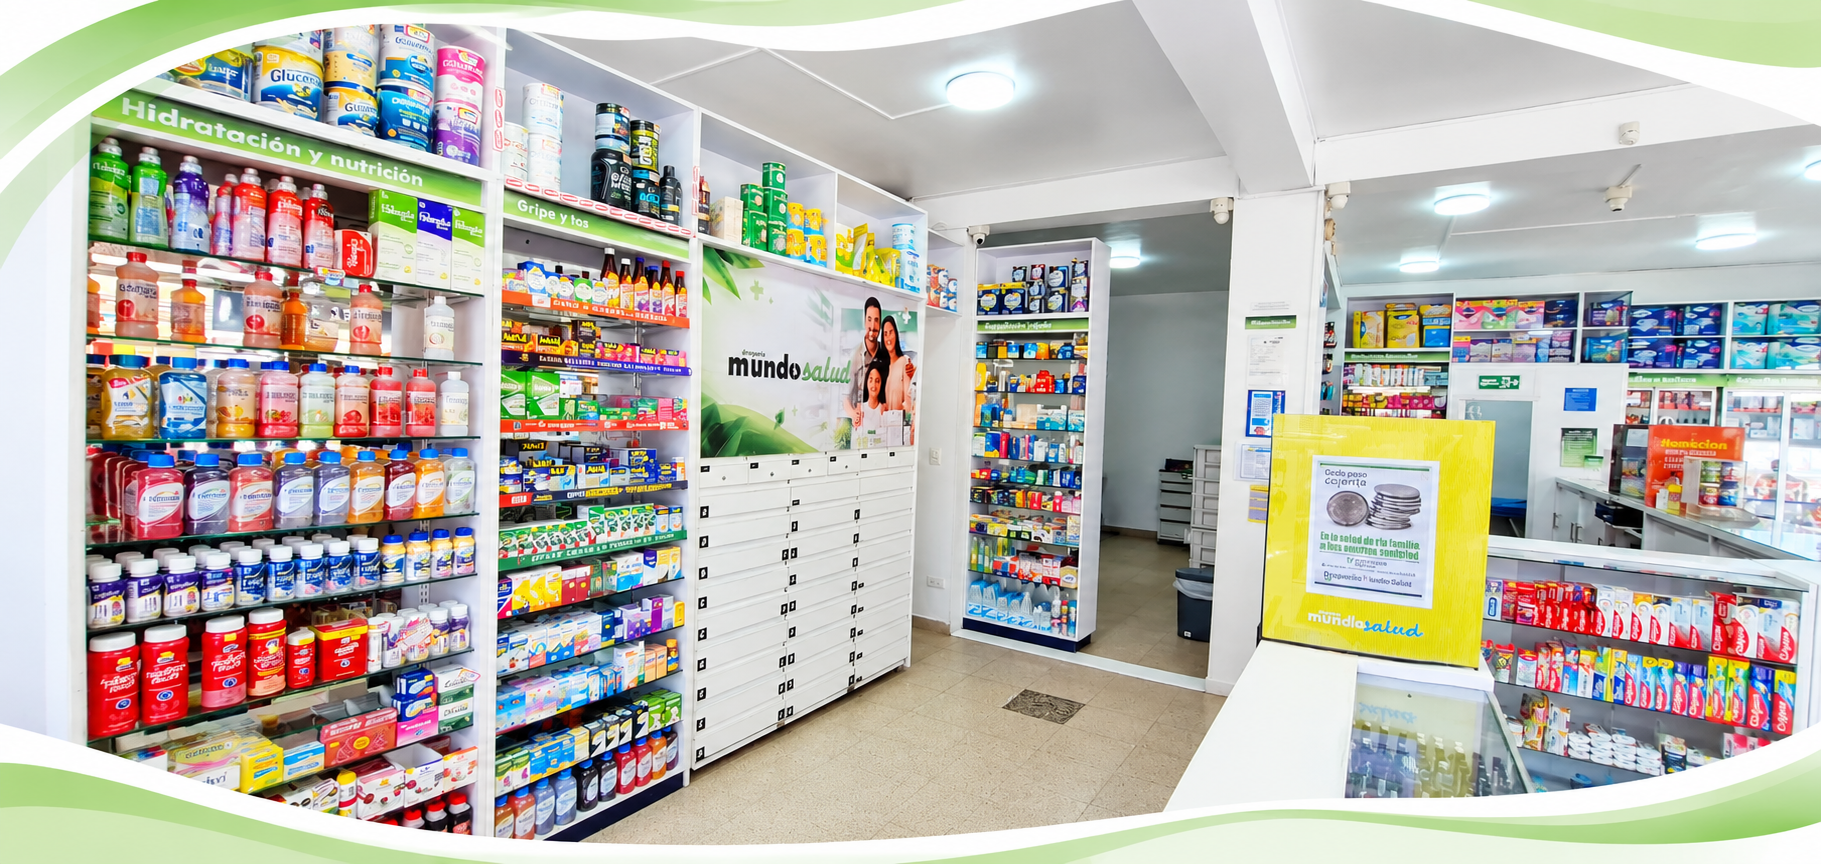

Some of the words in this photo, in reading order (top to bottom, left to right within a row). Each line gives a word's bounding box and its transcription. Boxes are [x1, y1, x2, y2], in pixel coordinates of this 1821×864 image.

[122, 97, 301, 157] Hidratación
[309, 148, 325, 166] y
[331, 153, 424, 187] nutrición
[517, 200, 555, 220] Gripe
[560, 213, 569, 225] y
[571, 214, 589, 228] tos
